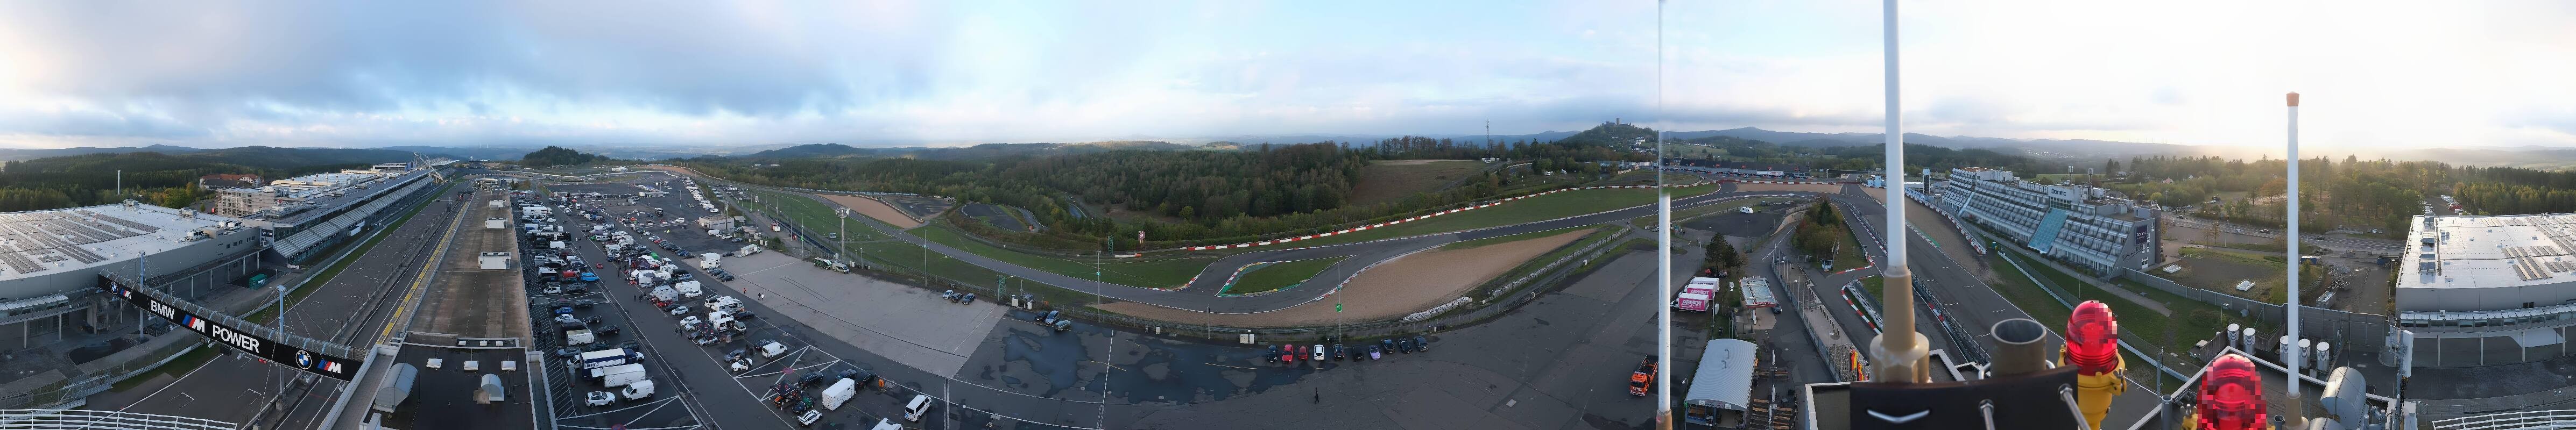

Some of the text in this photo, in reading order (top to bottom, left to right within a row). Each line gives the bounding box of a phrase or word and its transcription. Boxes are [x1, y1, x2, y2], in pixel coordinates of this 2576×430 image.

[151, 300, 259, 353] BMW M POWER
[327, 362, 341, 374] M
